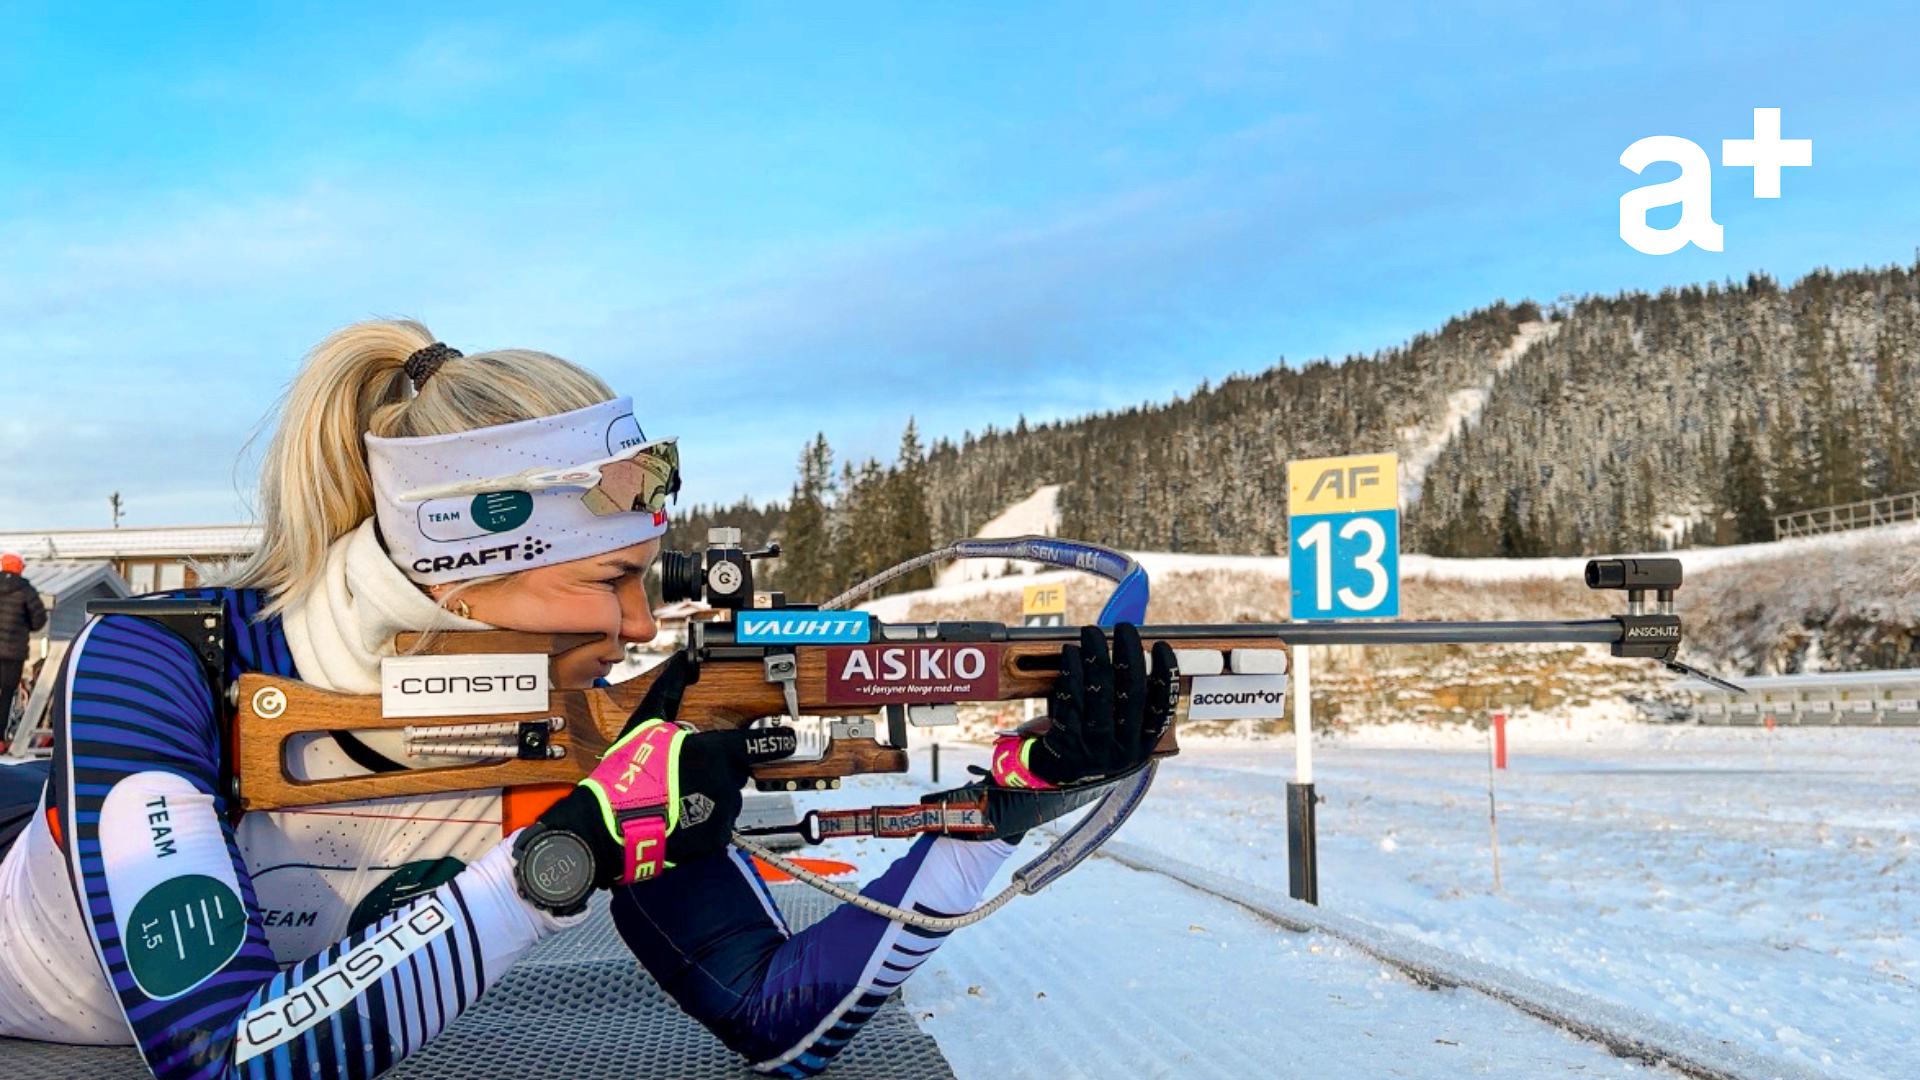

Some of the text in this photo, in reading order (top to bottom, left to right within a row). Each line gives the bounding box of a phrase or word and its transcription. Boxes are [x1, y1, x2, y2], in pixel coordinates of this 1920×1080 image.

[1305, 466, 1380, 502] AF
[428, 511, 461, 523] TEAM
[412, 543, 520, 574] CRAFT
[1297, 517, 1390, 611] 13
[1030, 590, 1059, 608] AF
[743, 620, 863, 635] VAUHTI
[840, 649, 986, 681] ASKO
[907, 684, 932, 695] Norge
[614, 726, 668, 793] LEKI
[146, 795, 177, 858] TEAM
